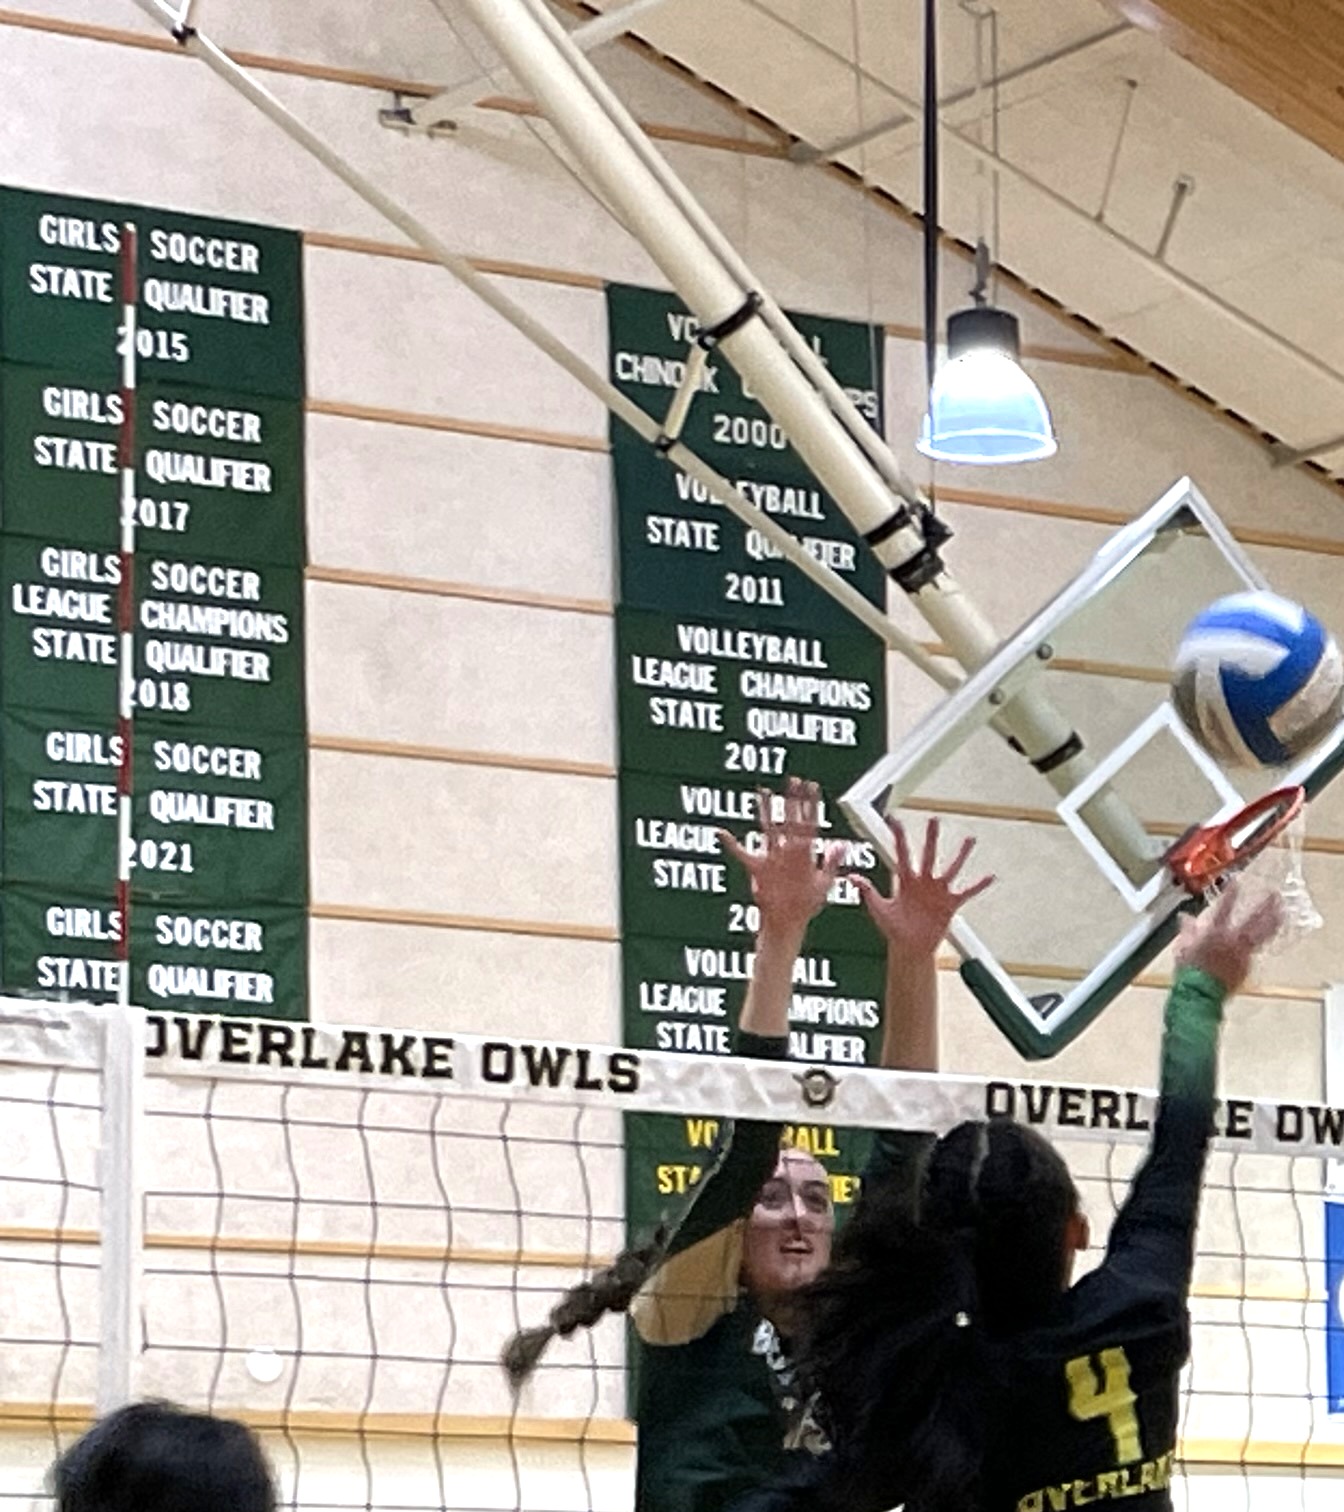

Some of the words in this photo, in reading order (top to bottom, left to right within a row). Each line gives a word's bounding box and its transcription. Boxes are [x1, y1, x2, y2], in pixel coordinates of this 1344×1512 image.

[39, 214, 121, 254] GIRLS
[150, 230, 259, 274] SOCCER
[29, 264, 113, 303] STATE
[144, 279, 269, 324] QUALIFIER
[615, 352, 719, 393] CHINOK
[43, 387, 124, 425] GIRLS
[153, 401, 261, 443] SOCCER
[713, 414, 786, 450] 2000
[34, 436, 118, 473] STATE
[146, 450, 272, 492] QUALIFIER
[647, 515, 720, 552] STATE
[41, 547, 122, 584] GIRLS
[151, 560, 260, 601] SOCCER
[725, 572, 784, 606] 2011
[13, 584, 111, 625] LEAGUE
[141, 601, 288, 643] CHAMPIONS
[32, 629, 116, 664] STATE
[146, 640, 270, 682] QUALIFIER
[677, 624, 828, 669] VOLLEYBALL
[632, 654, 718, 694] LEAGUE
[740, 669, 871, 711] CHAMPIONS
[650, 697, 724, 732] STATE
[747, 707, 858, 746] QUALIFIER
[46, 731, 124, 766] GIRLS
[154, 741, 261, 780] SOCCER
[724, 742, 787, 775] 2017
[33, 781, 117, 816] STATE
[150, 791, 274, 830] QUALIFIER
[635, 817, 721, 854] LEAGUE
[653, 858, 727, 893] STATE
[46, 907, 123, 940] GIRLS
[156, 915, 263, 952] SOCCER
[37, 956, 120, 992] STATE
[148, 964, 274, 1003] QUALIFIER
[640, 982, 726, 1016] LEAGUE
[656, 1021, 730, 1053] STATE
[481, 1042, 641, 1093] OWLS
[986, 1081, 1254, 1138] OVERLE
[1065, 1346, 1143, 1465] 4
